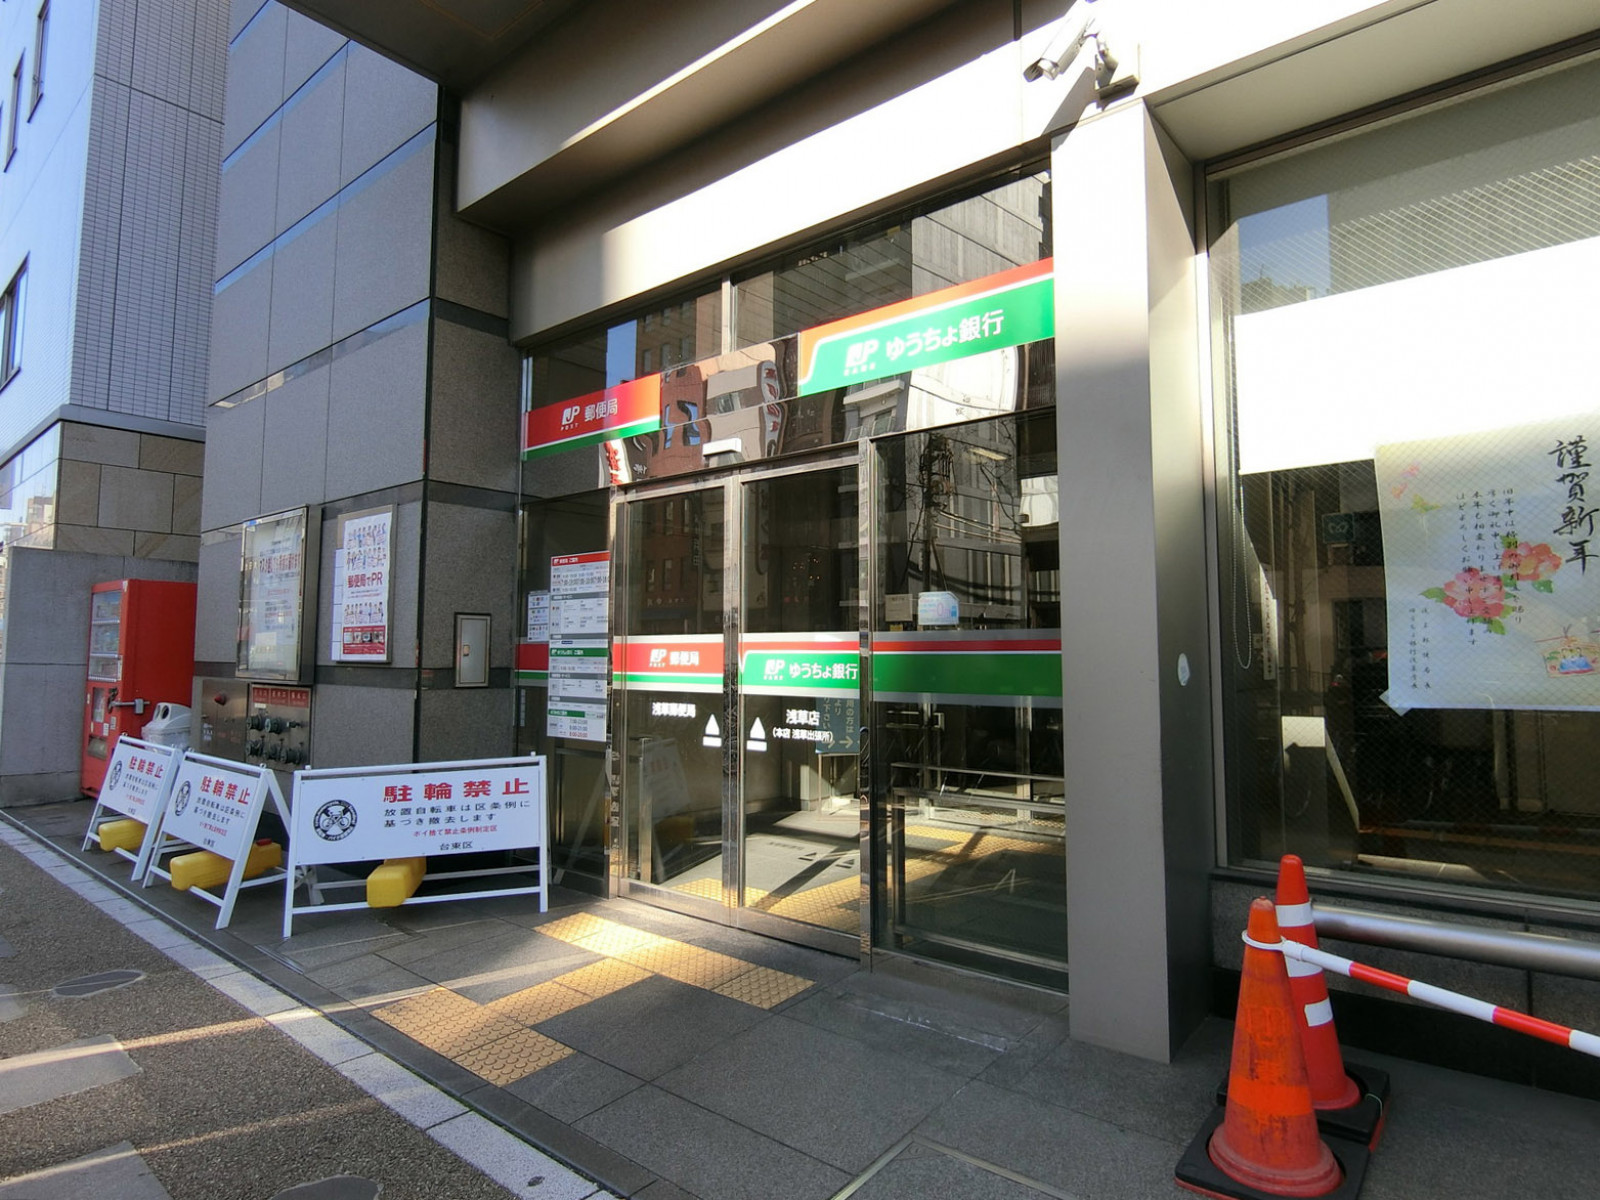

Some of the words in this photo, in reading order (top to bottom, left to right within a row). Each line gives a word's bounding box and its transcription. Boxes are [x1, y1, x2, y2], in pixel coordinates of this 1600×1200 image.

[885, 309, 1004, 361] ゆうちょ銀行
[584, 398, 618, 422] 郵便局
[1547, 435, 1600, 576] 謹賀新年
[347, 571, 383, 589] 郵便局でPR
[788, 662, 858, 680] ゆうちょ銀行
[785, 709, 820, 726] 浅草店
[200, 775, 251, 805] 駐輪禁止
[383, 777, 530, 804] 駐輪禁止
[384, 800, 531, 817] 放置自転車は区条例に
[384, 813, 497, 828] 基づき撤去します
[413, 824, 498, 838] ポイ捨て禁止条例制定区
[439, 840, 473, 851] 台東区
